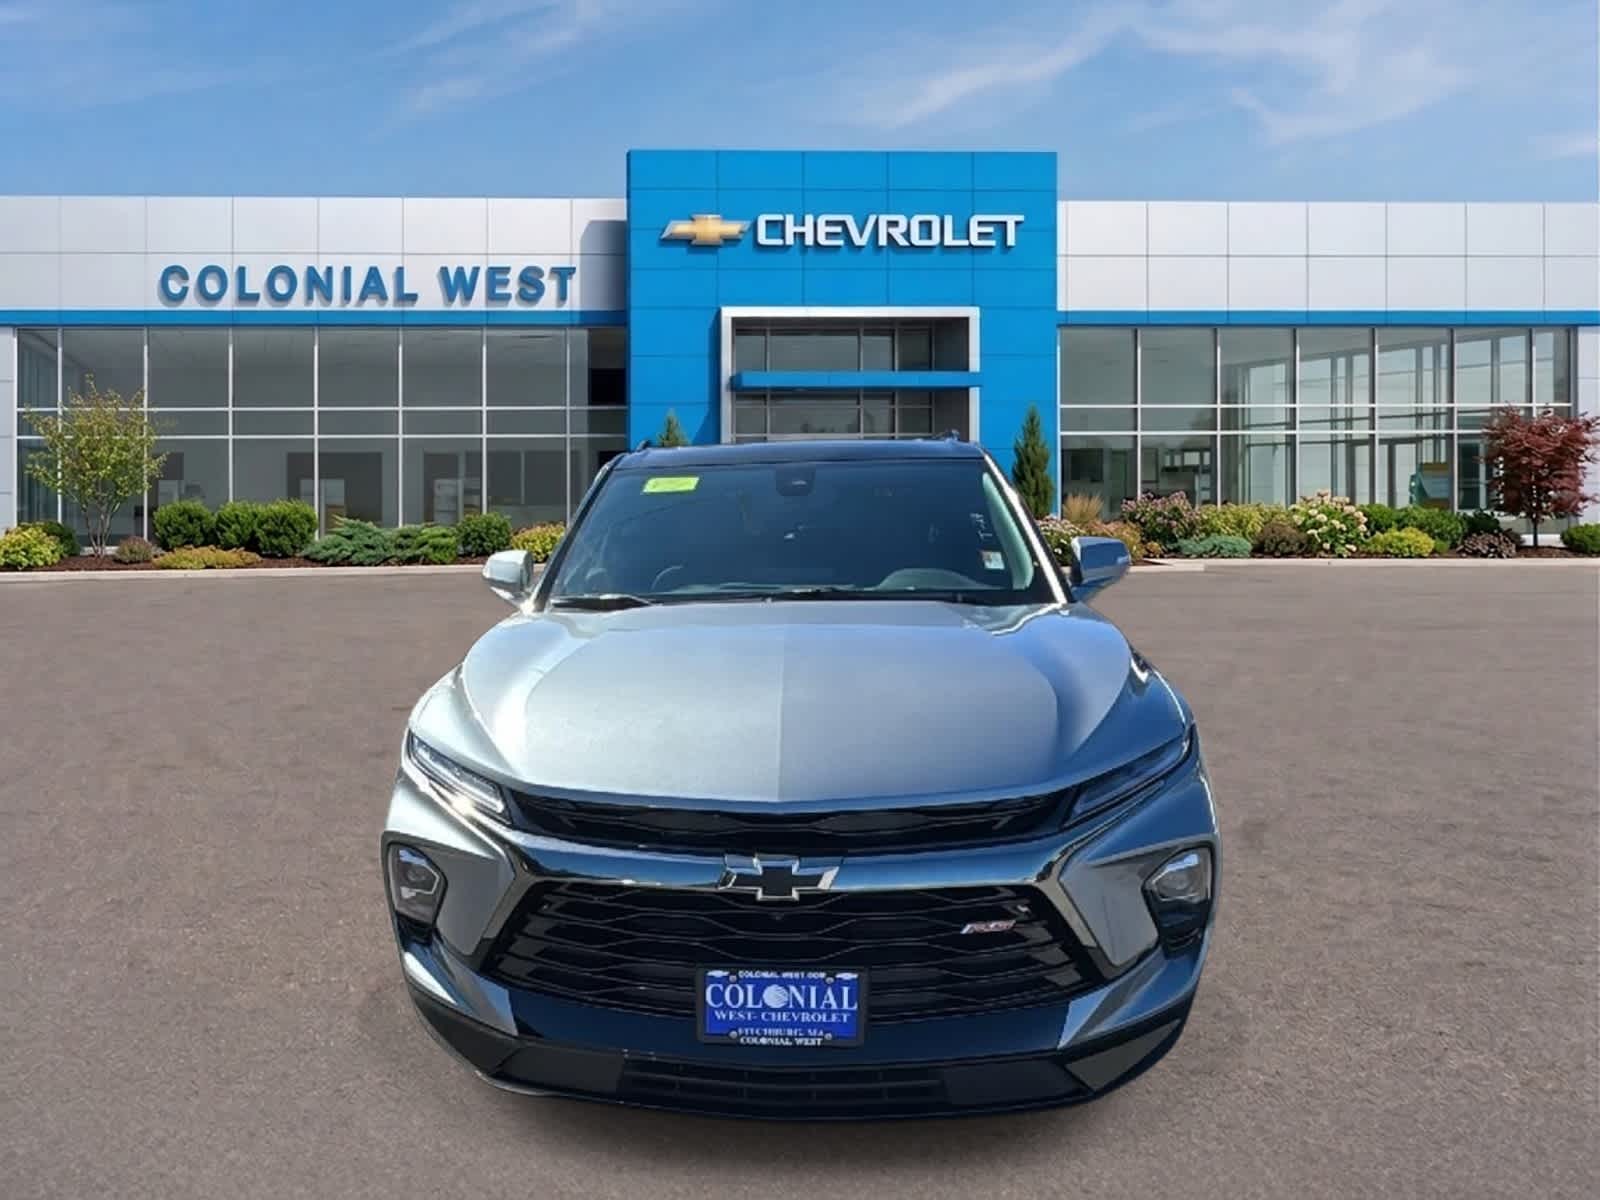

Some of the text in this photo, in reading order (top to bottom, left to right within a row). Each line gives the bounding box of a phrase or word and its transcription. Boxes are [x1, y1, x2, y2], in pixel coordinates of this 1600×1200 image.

[756, 213, 1025, 248] CHEVROLET
[158, 265, 578, 305] COLONIAL WEST
[706, 983, 858, 1010] COLONIAL
[761, 1011, 851, 1023] CHEVROLET
